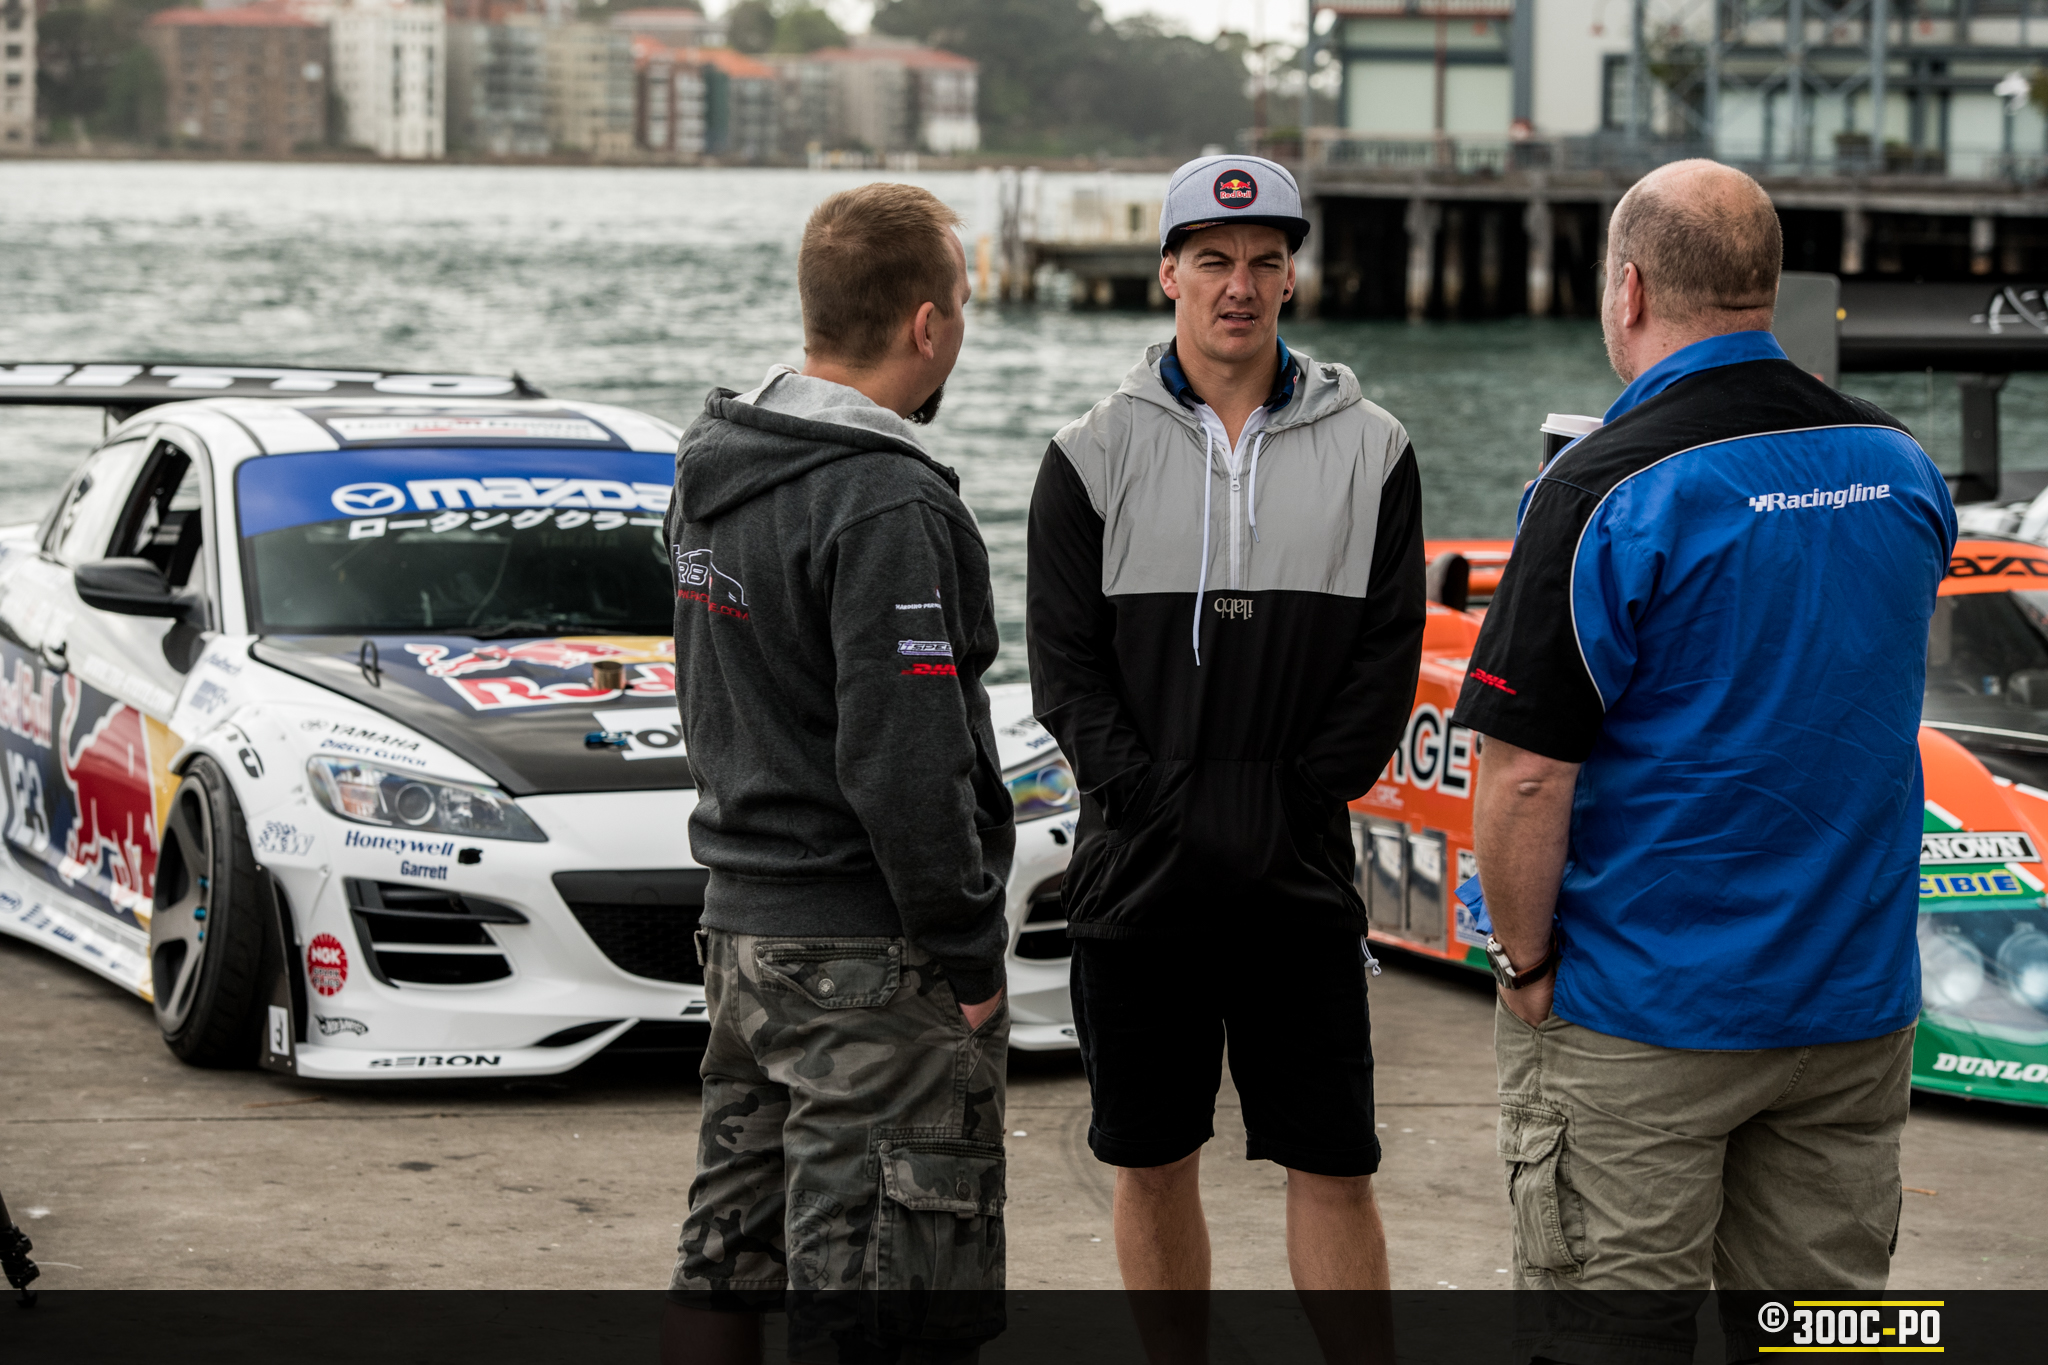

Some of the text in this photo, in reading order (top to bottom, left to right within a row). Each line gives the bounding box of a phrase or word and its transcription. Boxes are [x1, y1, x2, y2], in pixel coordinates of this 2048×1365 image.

[1220, 190, 1252, 199] Red Bull
[1766, 483, 1891, 512] Racingline
[1214, 598, 1254, 620] ilabb
[1473, 668, 1511, 692] DHL
[331, 723, 420, 751] YAMAHA
[320, 739, 427, 768] DIRECT CLUTCH
[345, 830, 455, 857] Honeywell
[400, 860, 449, 880] Garrett
[311, 946, 341, 965] NGK
[1933, 1053, 2048, 1084] DUNLO
